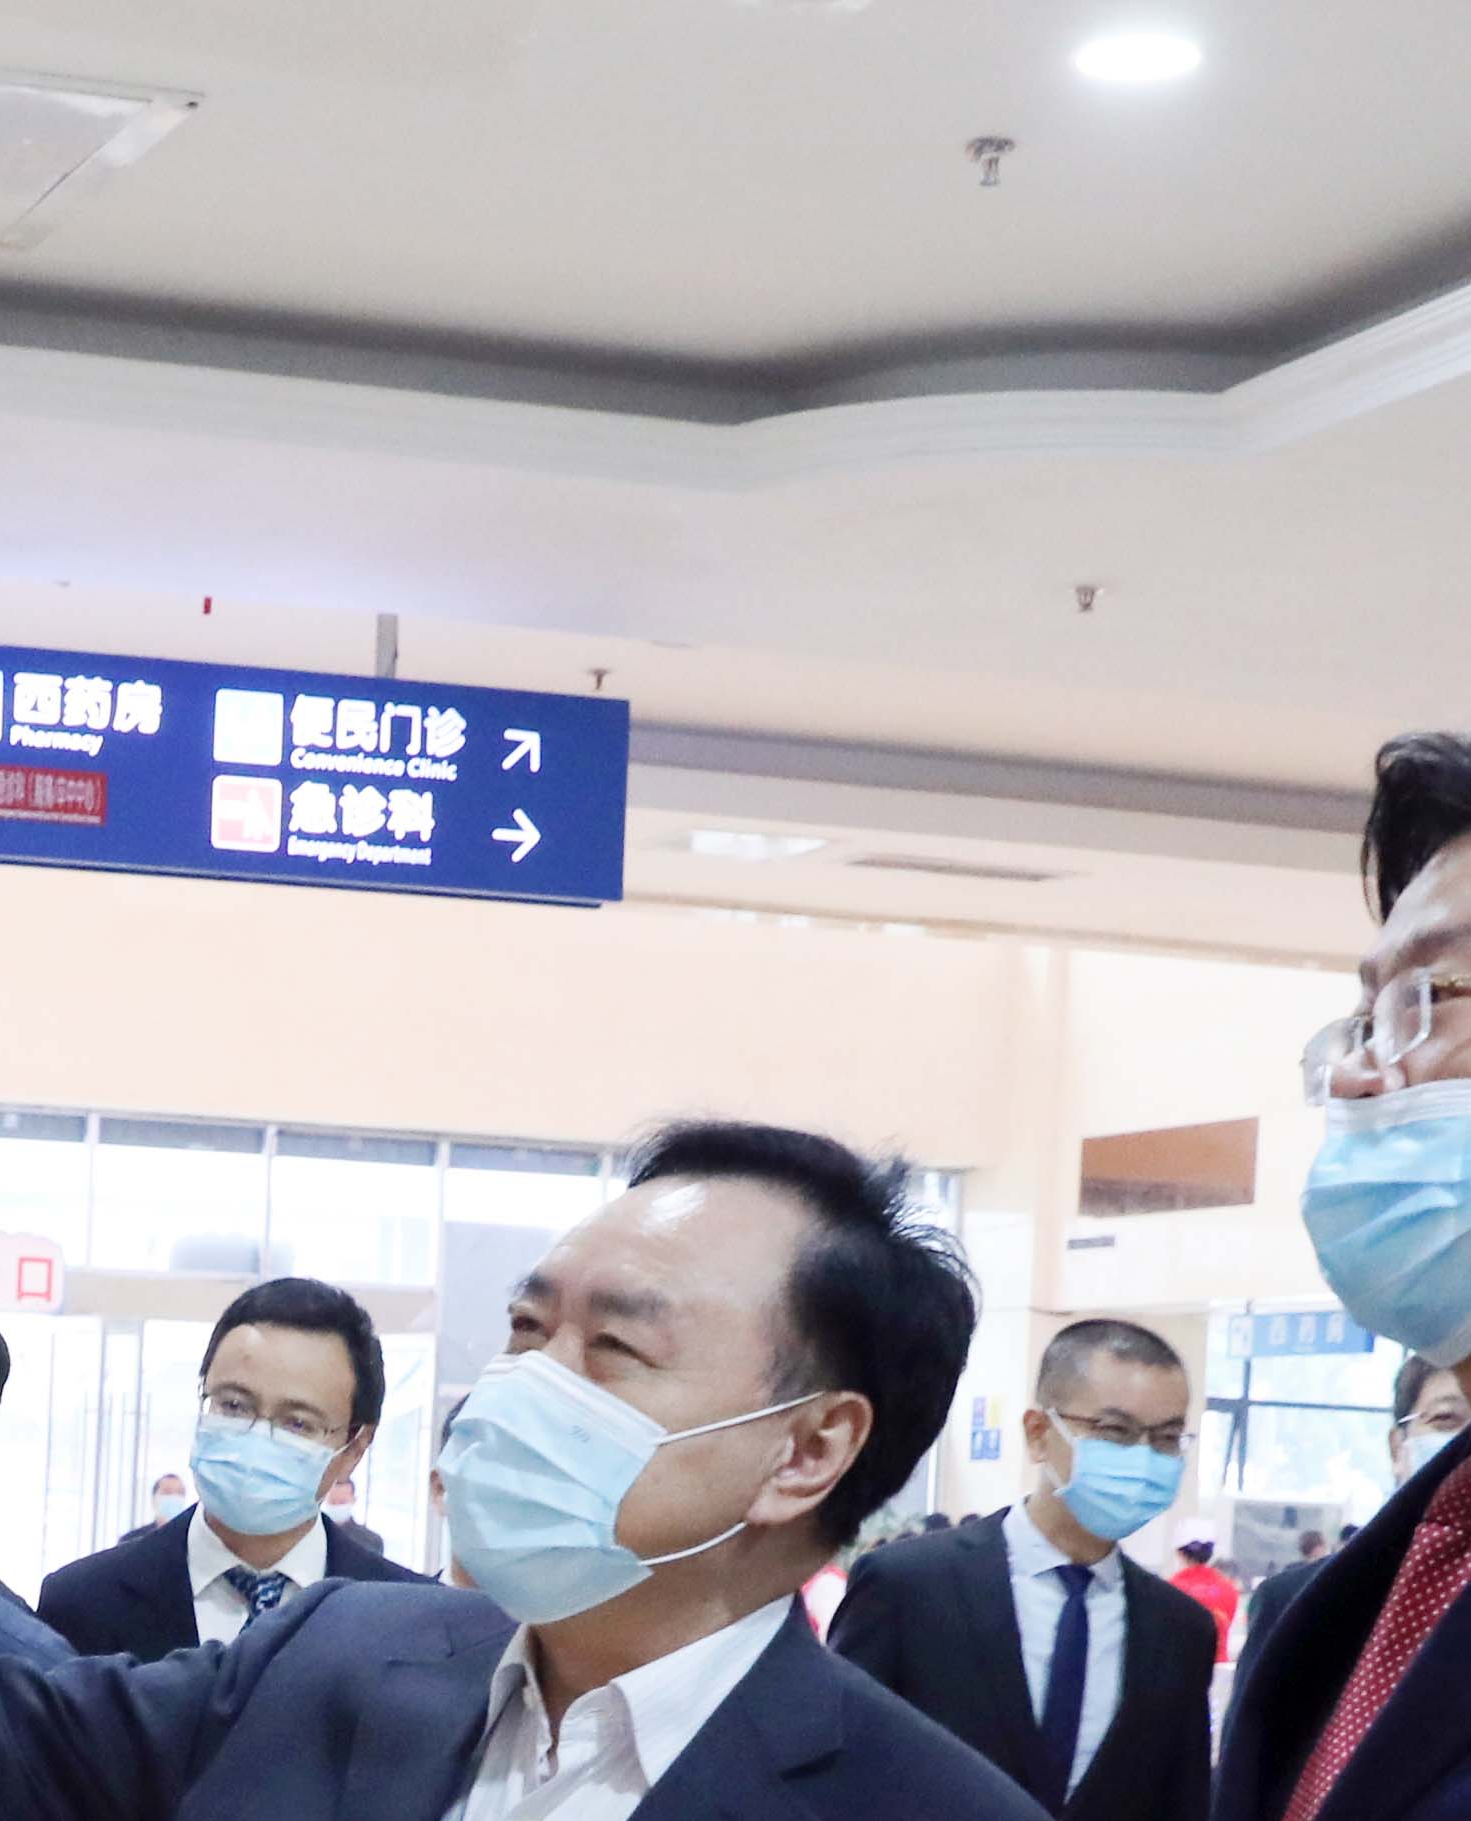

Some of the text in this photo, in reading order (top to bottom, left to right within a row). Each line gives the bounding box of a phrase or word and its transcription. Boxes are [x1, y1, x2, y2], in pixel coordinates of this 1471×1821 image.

[12, 671, 163, 735] 西药房
[289, 693, 468, 759] 便民门诊
[9, 724, 104, 757] Pharmacy
[289, 747, 459, 782] Convenience Clinic
[288, 780, 436, 842] 急诊科
